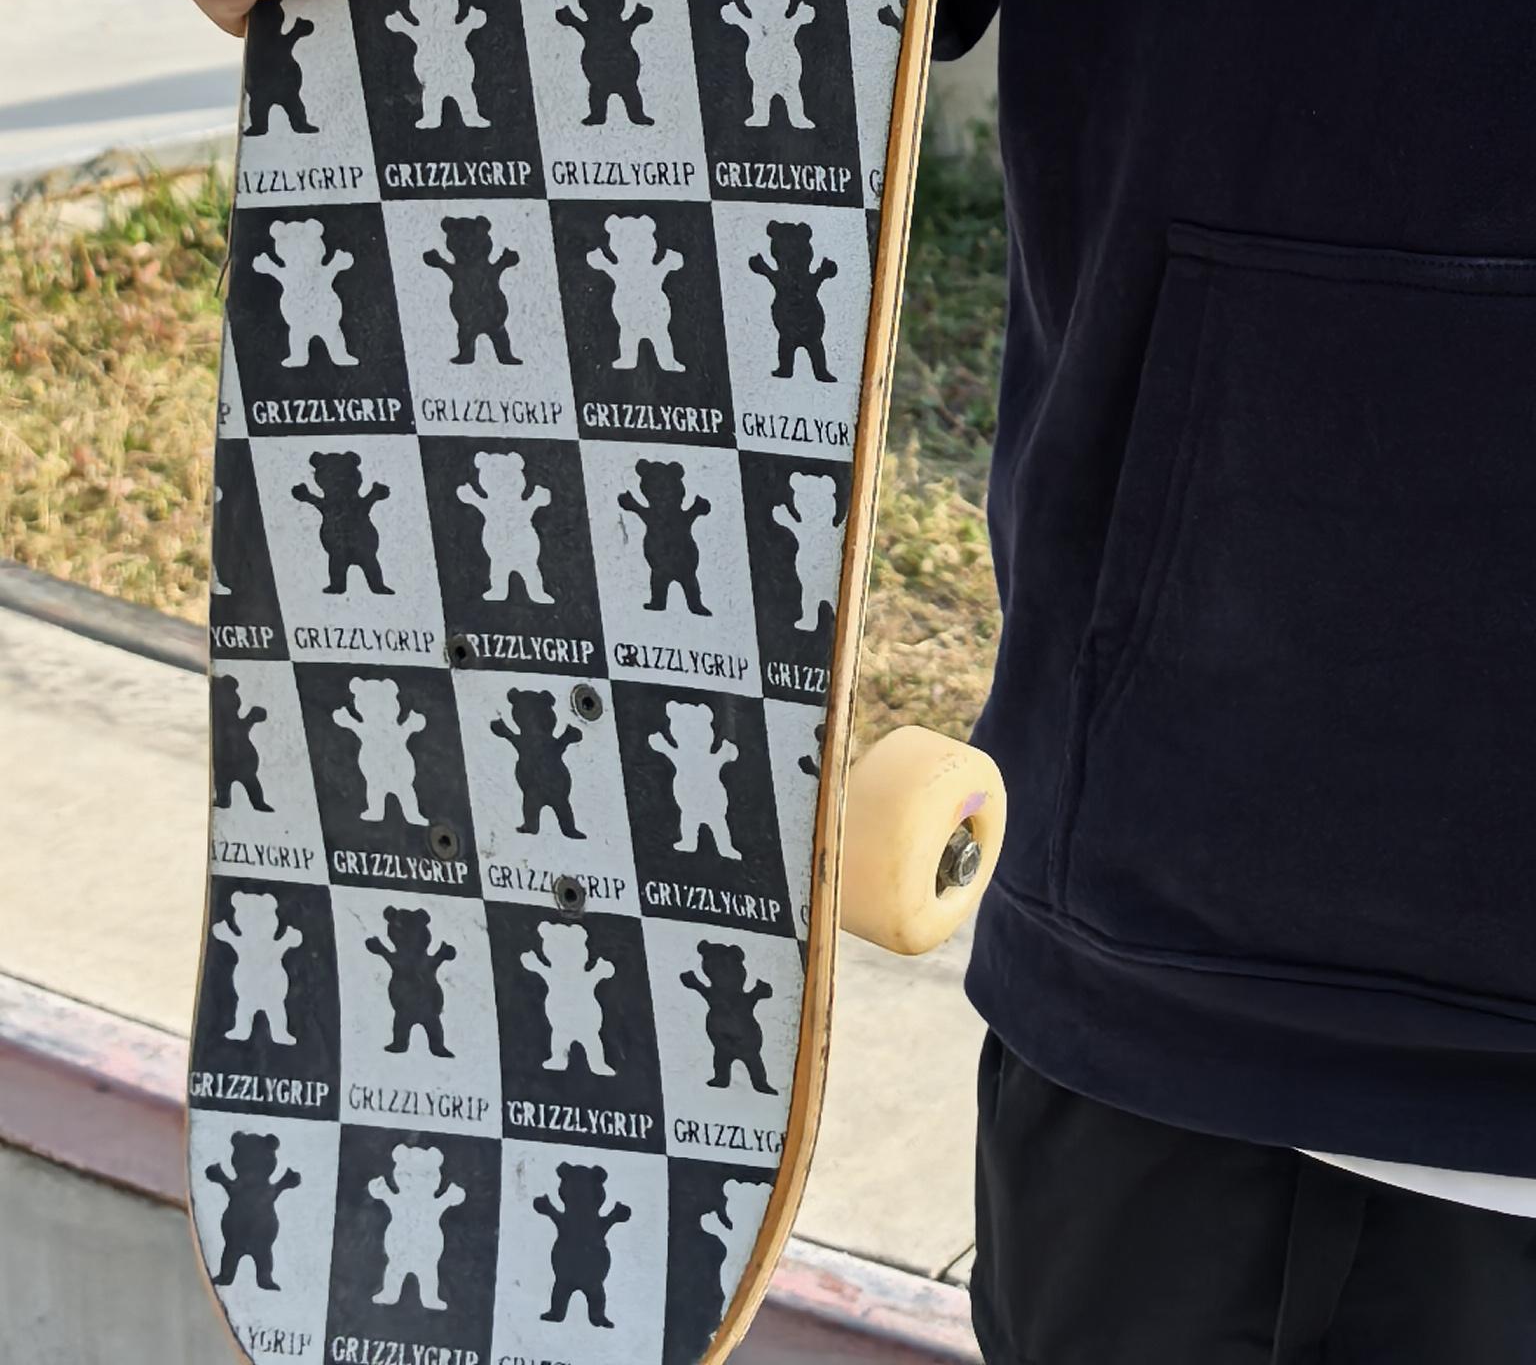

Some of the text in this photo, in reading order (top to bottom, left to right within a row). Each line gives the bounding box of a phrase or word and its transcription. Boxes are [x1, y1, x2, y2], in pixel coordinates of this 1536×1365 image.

[237, 167, 363, 194] IZZLYGRIP
[385, 161, 531, 189] GRIZZLYGRIP
[553, 161, 696, 186] GRIZZLYGRIP
[716, 162, 851, 193] GRIZZLYGRIP
[253, 398, 401, 425] GRIZZLYGRIP
[422, 398, 562, 425] GRIZZLYGRIP
[583, 403, 723, 433] GRIZZLYGRIP
[295, 627, 434, 653] GRIZZLYGRIP
[467, 634, 594, 664] RIZZLYGRIP
[615, 643, 749, 681] GRIZZLYGRIP
[333, 850, 469, 884] GRIZZLYGRIP
[645, 881, 781, 923] GRIZZLYGRIP
[189, 1071, 329, 1107] GRIZZLYGRIP
[349, 1083, 489, 1122] GRIZZLYGRIP
[507, 1100, 654, 1139] GRIZZLYGRIP
